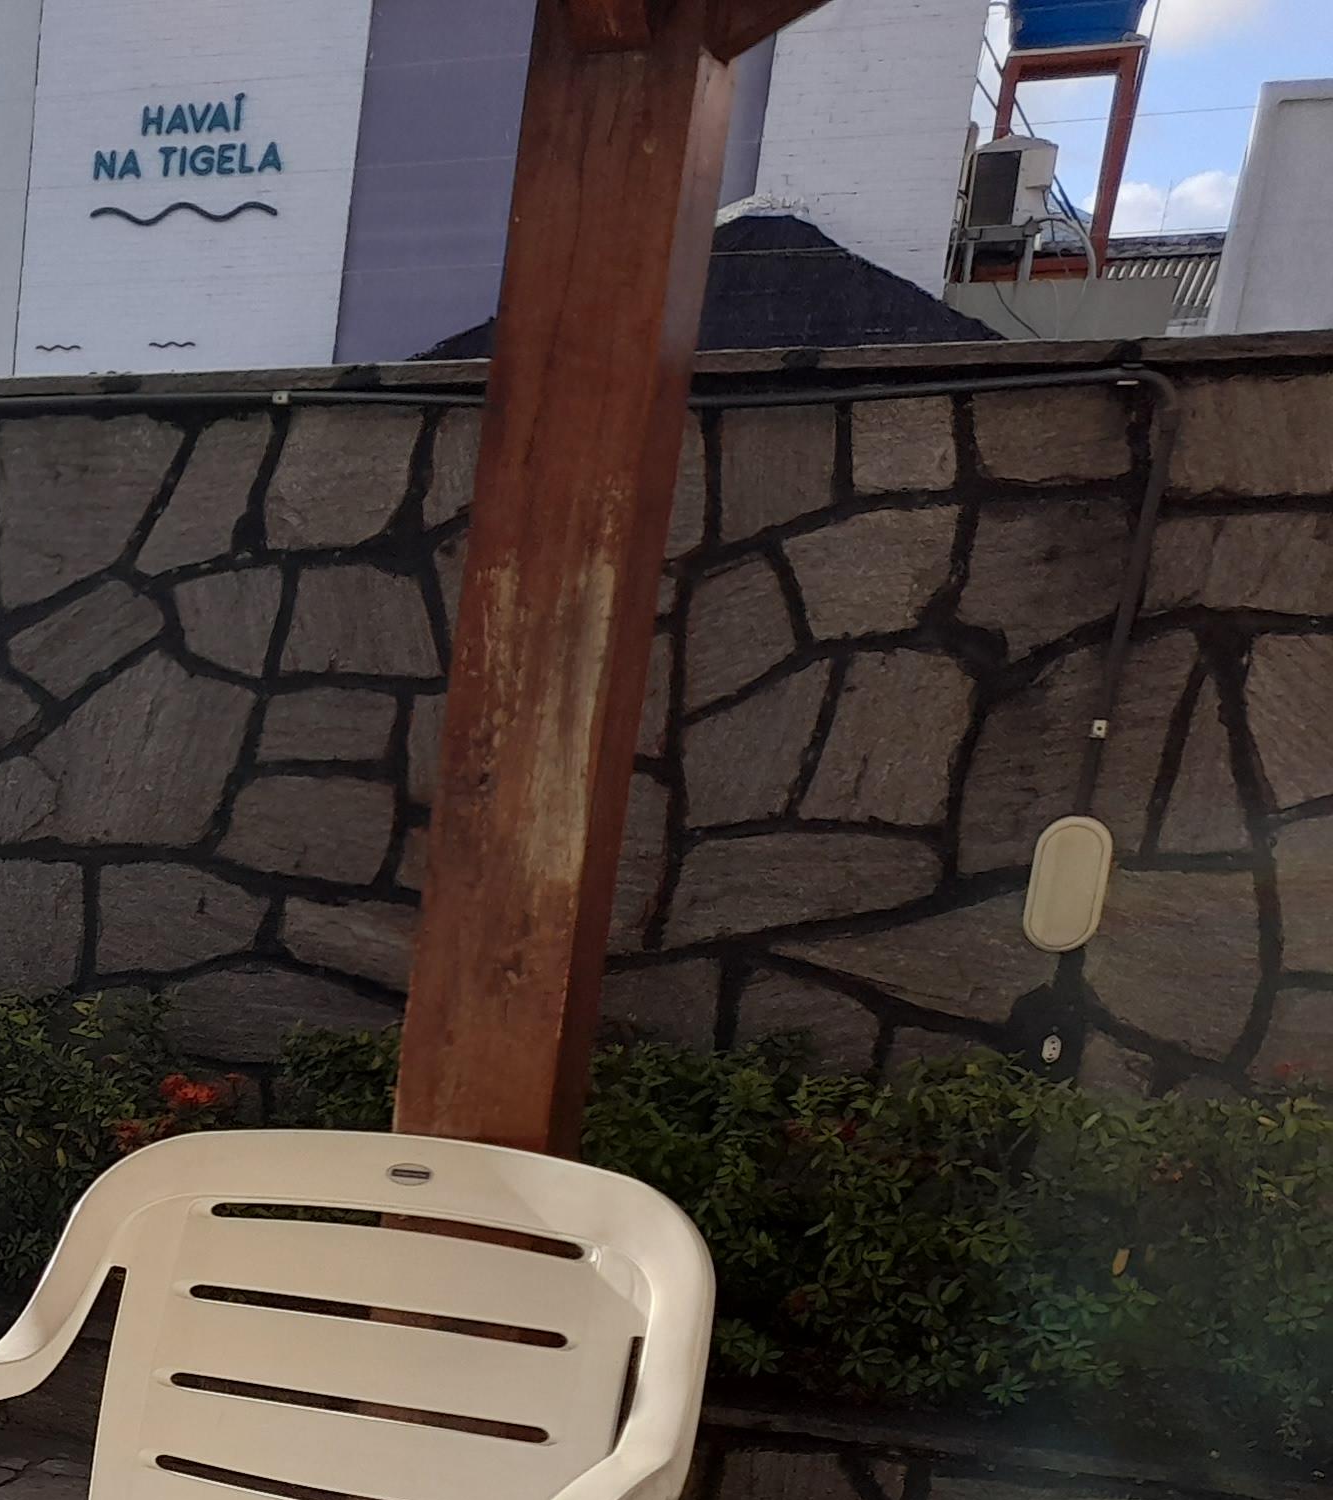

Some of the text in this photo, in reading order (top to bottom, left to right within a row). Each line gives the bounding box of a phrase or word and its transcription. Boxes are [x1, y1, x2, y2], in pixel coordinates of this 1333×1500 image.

[141, 92, 245, 136] HAVAÍ
[93, 142, 282, 180] NA TIGELA
